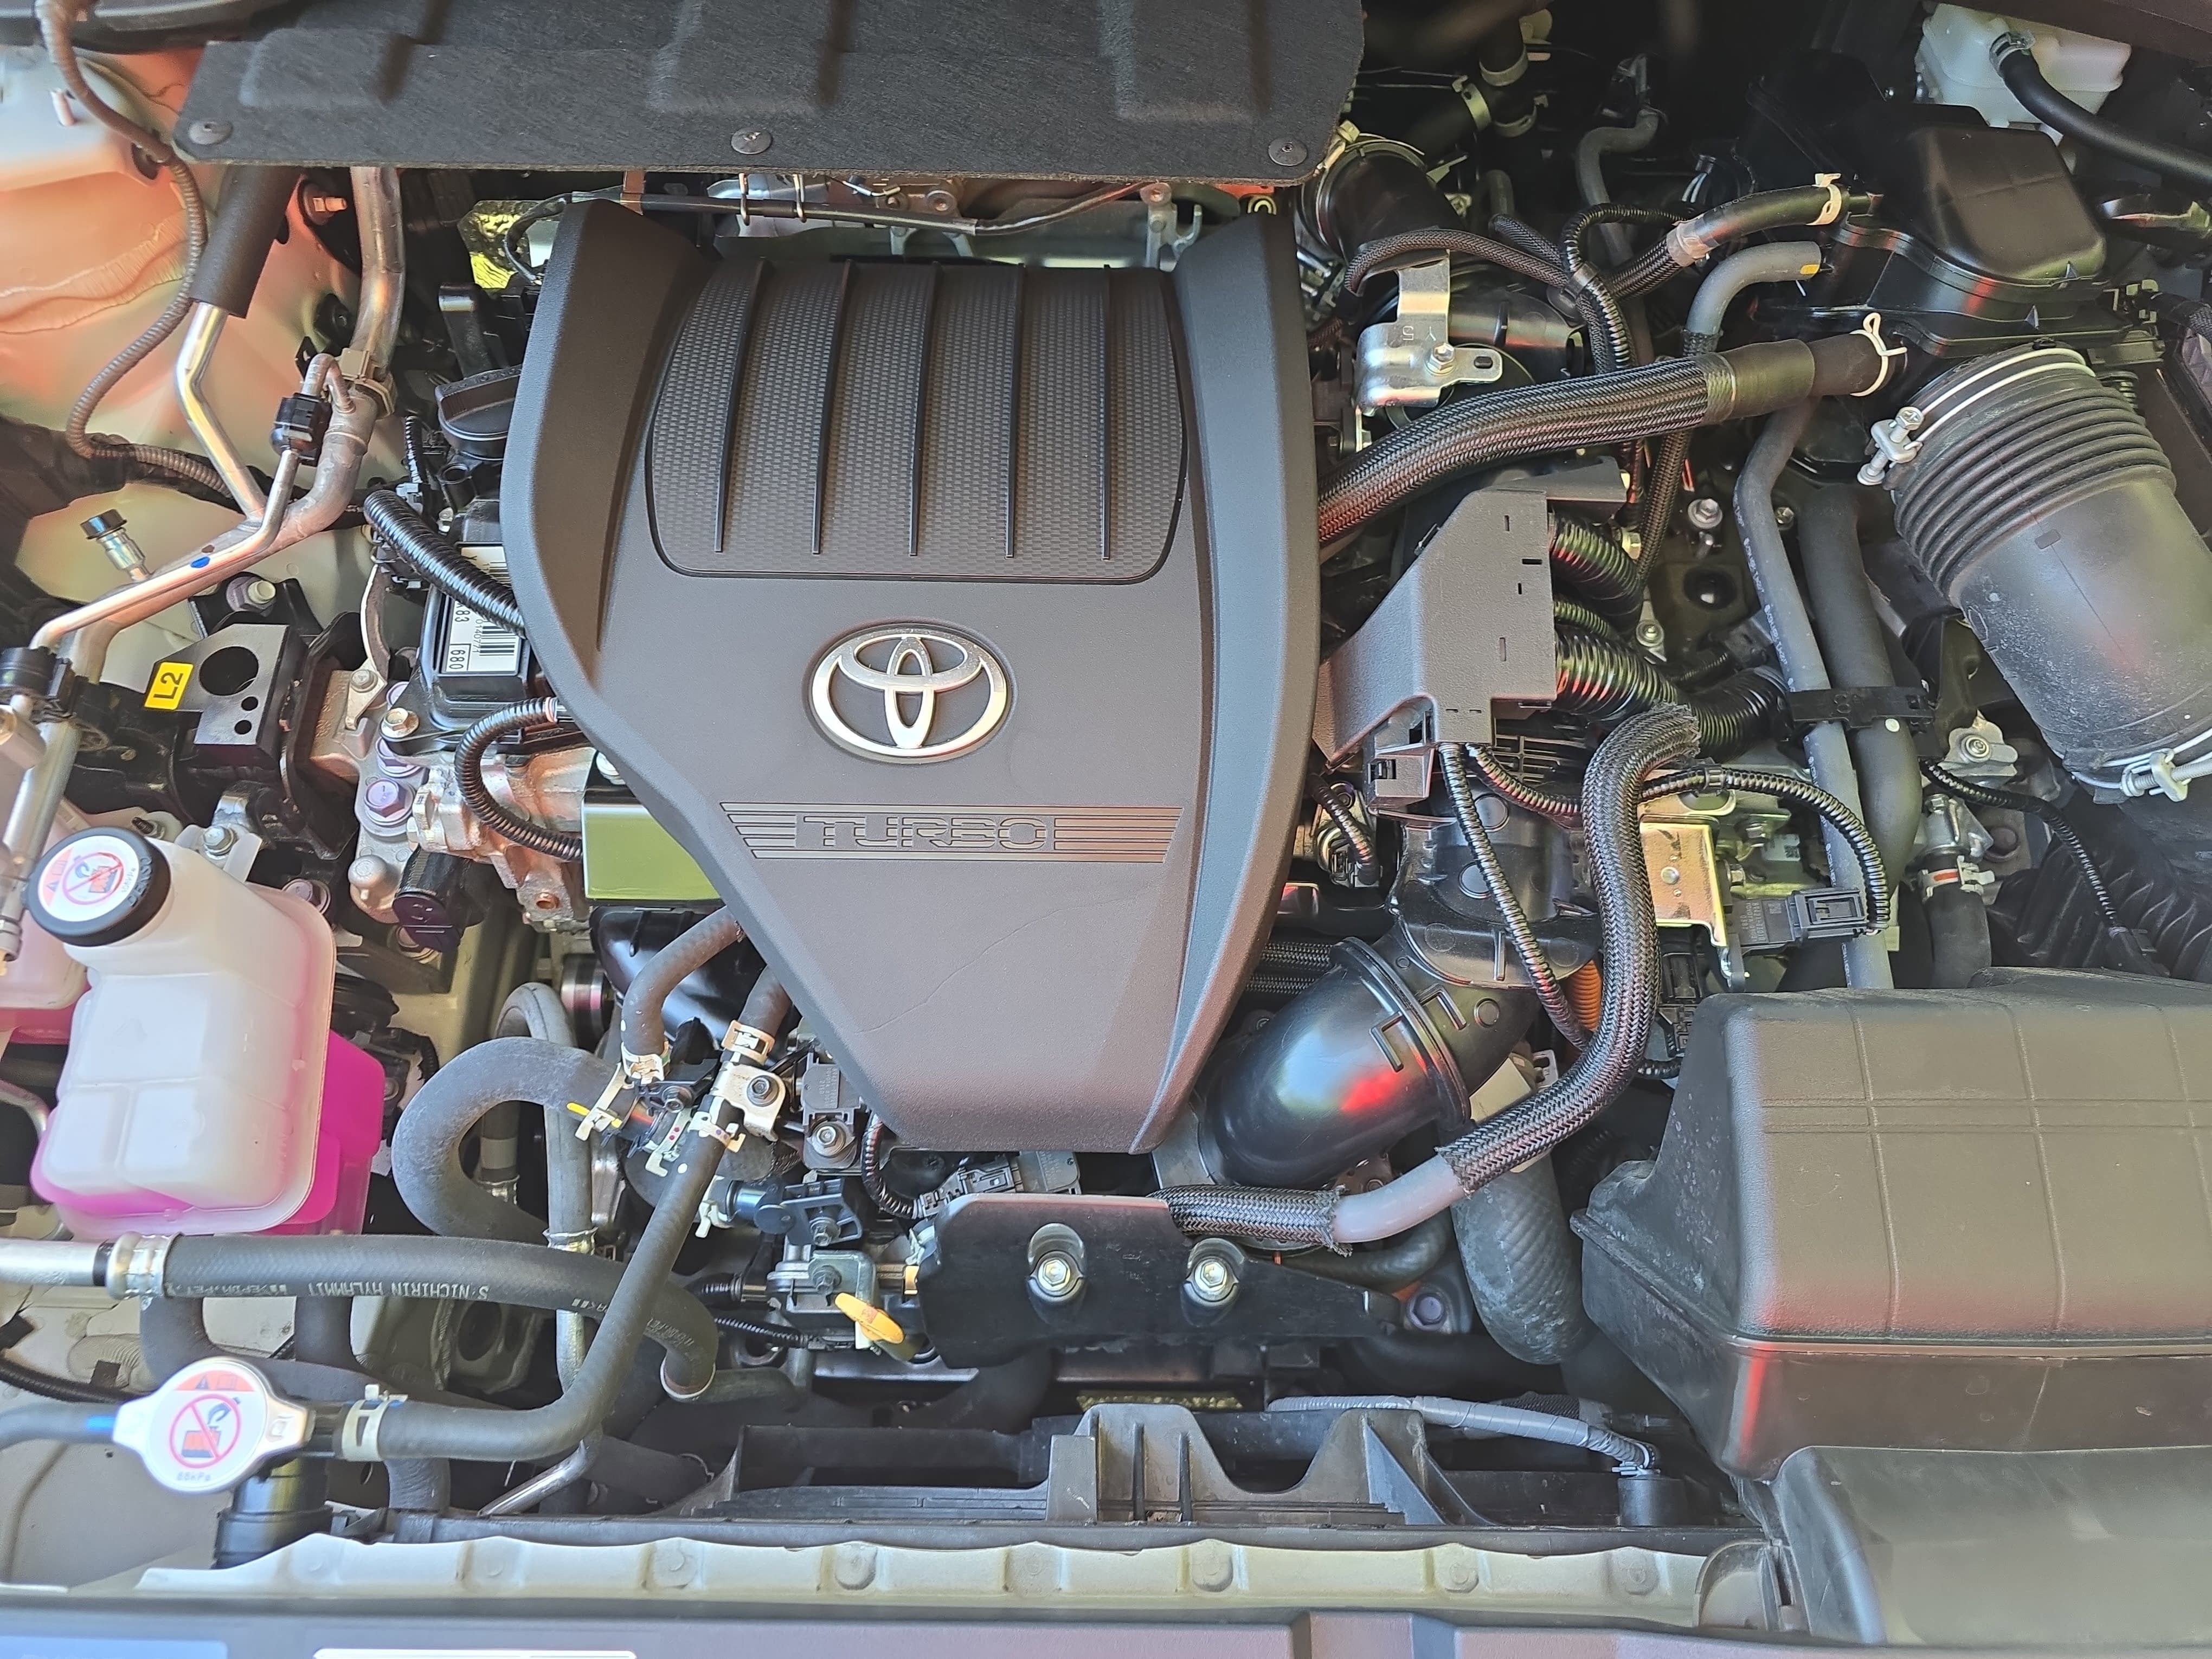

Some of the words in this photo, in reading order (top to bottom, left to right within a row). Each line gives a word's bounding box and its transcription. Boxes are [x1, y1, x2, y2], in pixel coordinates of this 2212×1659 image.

[472, 619, 483, 653] 0140771
[449, 650, 465, 670] 680
[153, 672, 183, 699] L2
[803, 815, 1046, 850] TURBO
[128, 857, 152, 906] DENSO
